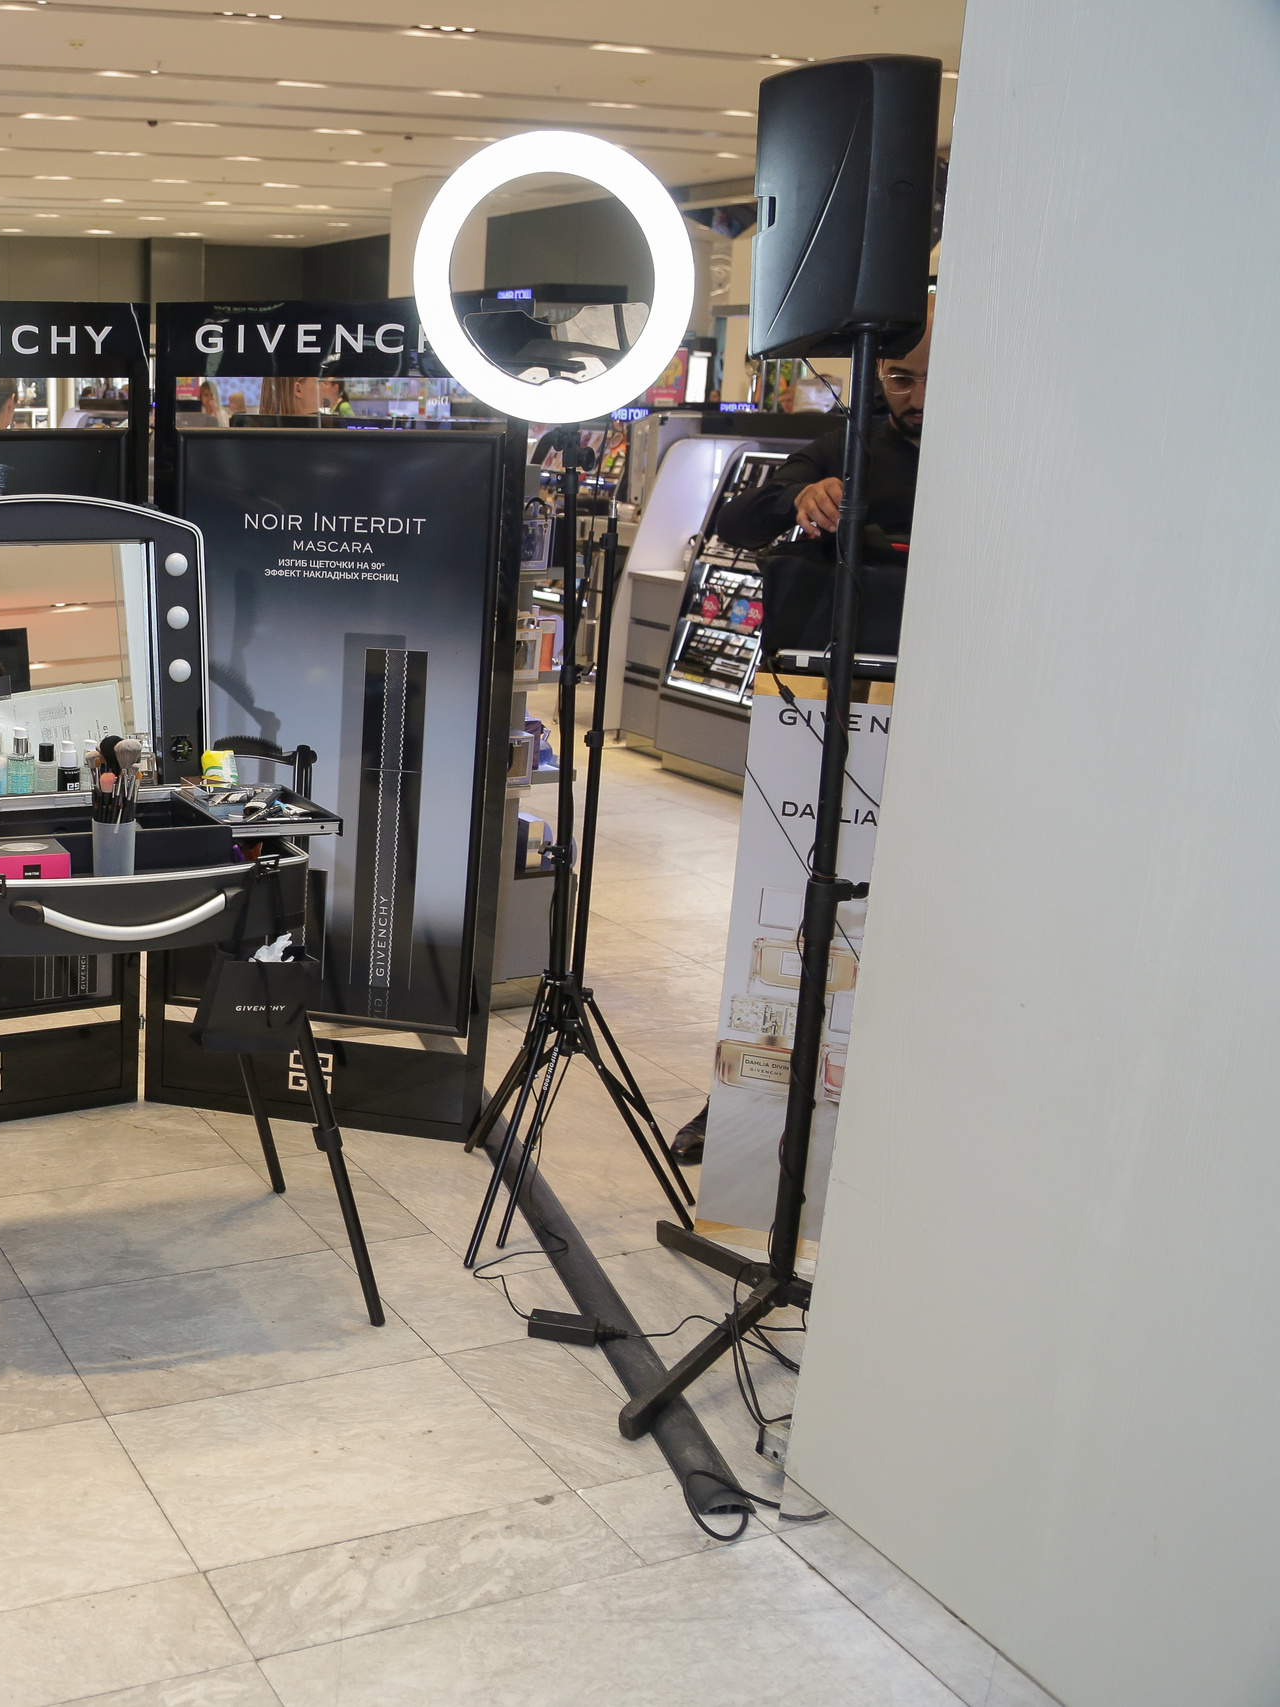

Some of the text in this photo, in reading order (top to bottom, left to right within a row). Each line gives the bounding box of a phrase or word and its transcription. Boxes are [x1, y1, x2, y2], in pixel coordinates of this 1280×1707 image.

[244, 513, 303, 531] NOIR
[293, 540, 373, 554] MASCARA
[278, 559, 385, 571] ИЗГИБ ЩЕТОЧКИ НА 90°
[264, 568, 399, 583] ЭФФЕКТ НАКЛАДНЫХ РЕСНИЦ
[781, 801, 877, 827] DALIA
[376, 896, 389, 977] GIVENCHY
[745, 1059, 770, 1068] DAHLIA
[750, 1067, 782, 1076] GIVENCHY
